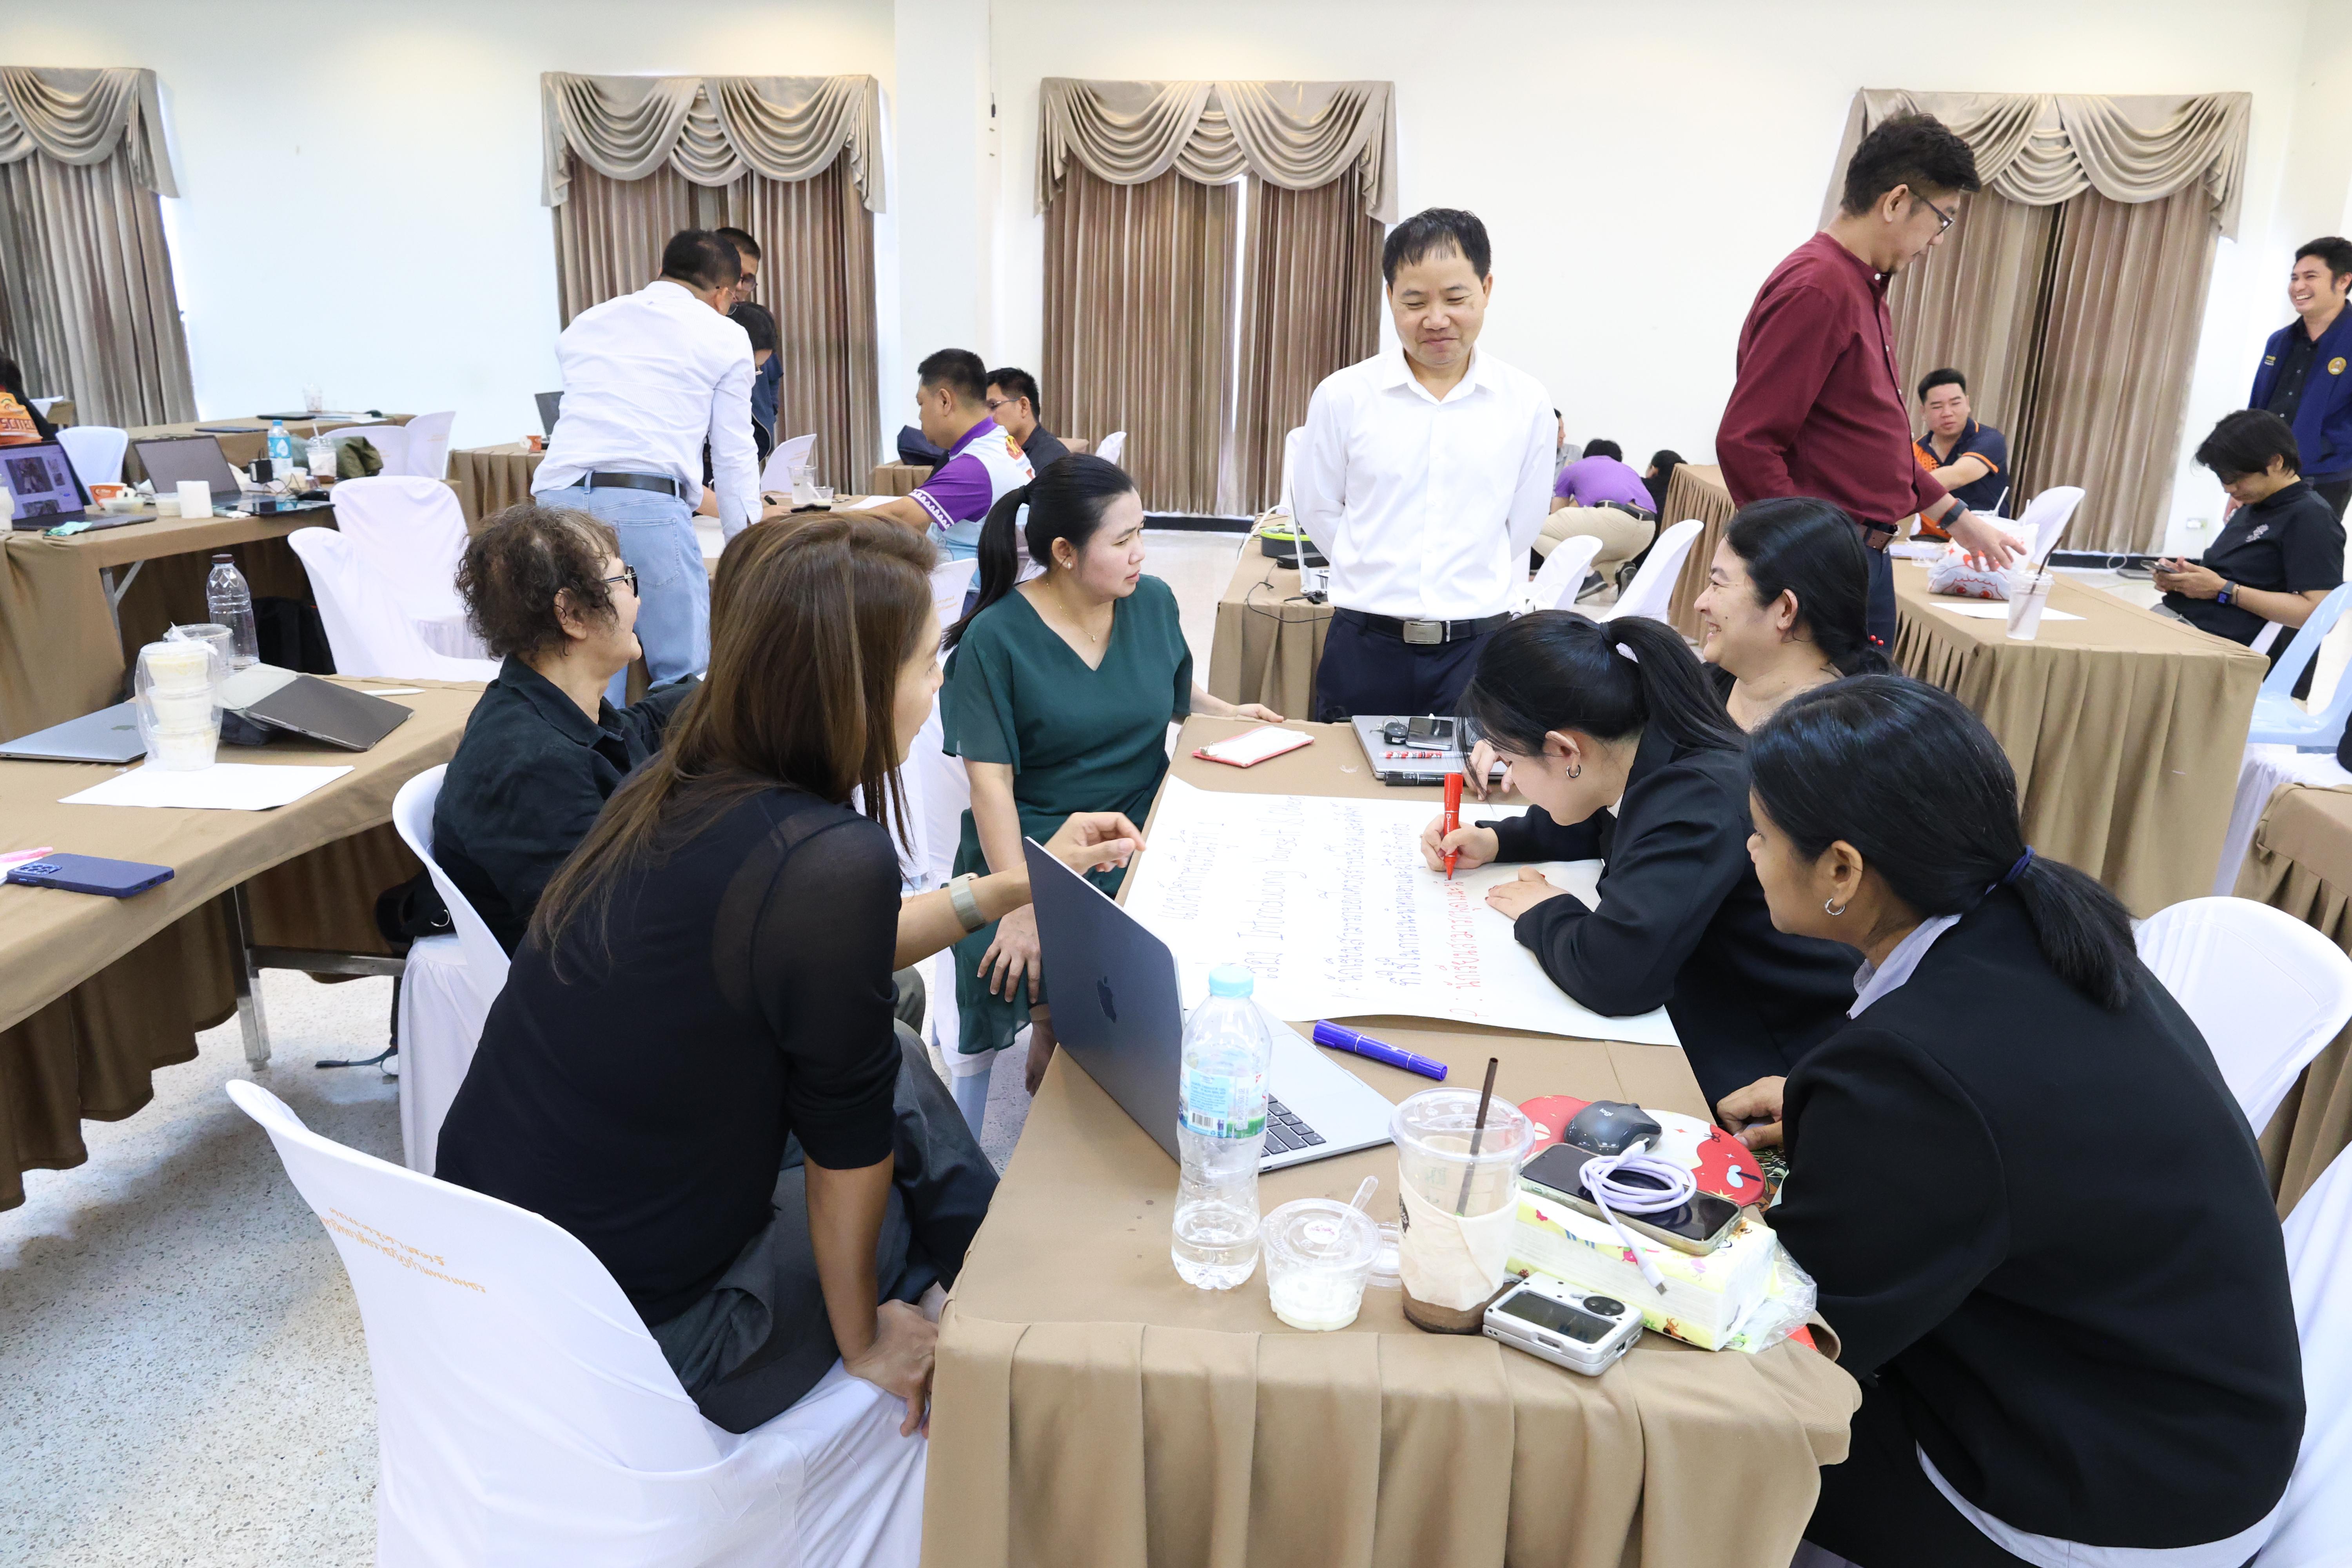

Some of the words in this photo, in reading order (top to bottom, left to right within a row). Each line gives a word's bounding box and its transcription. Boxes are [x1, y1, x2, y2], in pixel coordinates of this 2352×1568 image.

[1252, 829, 1301, 863] Yourself
[1237, 870, 1307, 941] Introducing
[1599, 1108, 1614, 1116] logi
